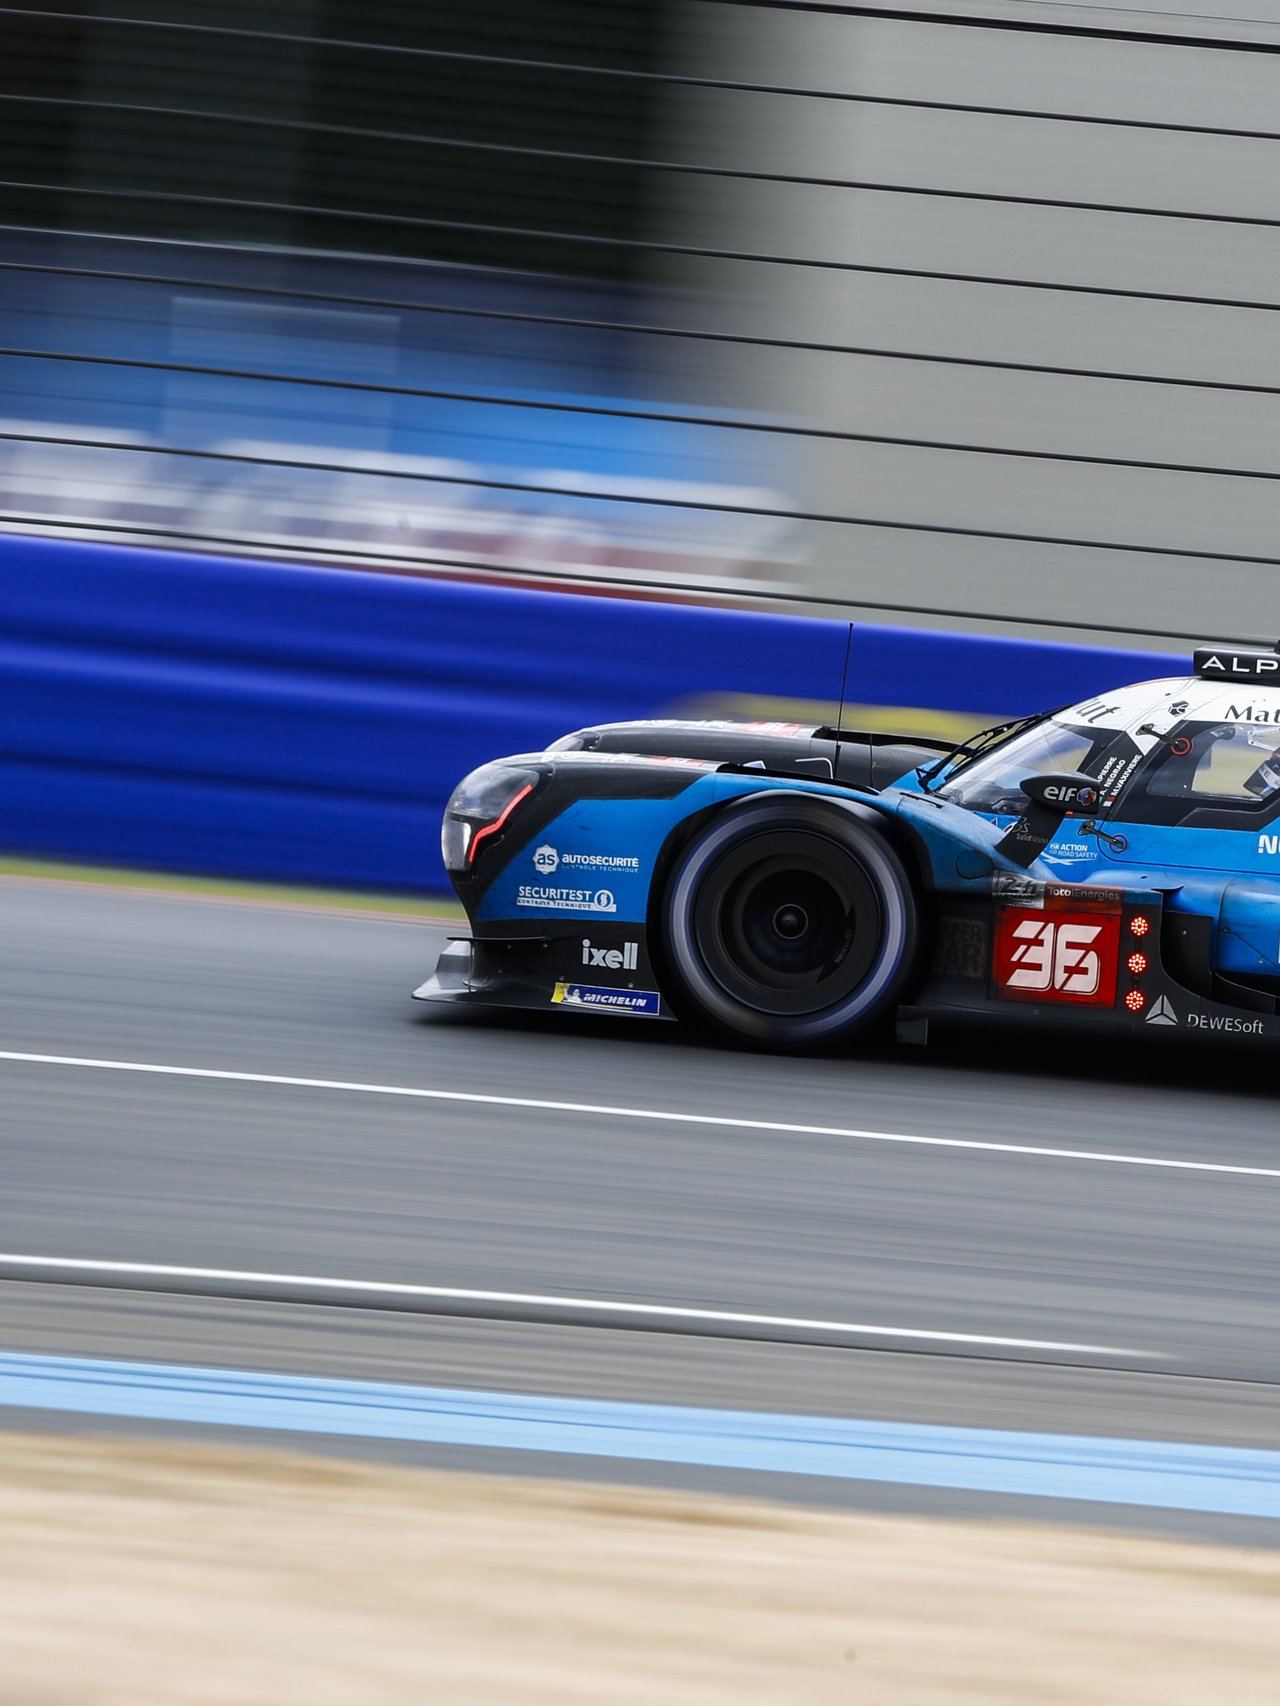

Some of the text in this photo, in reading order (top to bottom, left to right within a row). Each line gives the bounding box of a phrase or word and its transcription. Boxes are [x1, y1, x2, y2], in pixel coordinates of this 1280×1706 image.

[1043, 786, 1078, 802] elf
[1060, 843, 1089, 852] ACTION
[1075, 851, 1098, 859] SAFETY
[518, 886, 592, 901] SECURITEST
[1048, 886, 1120, 901] TotalEnergies
[582, 939, 638, 970] ixell
[1006, 920, 1102, 995] 36
[583, 993, 647, 1007] MICHELIN
[1187, 1014, 1264, 1035] DEWESoft
